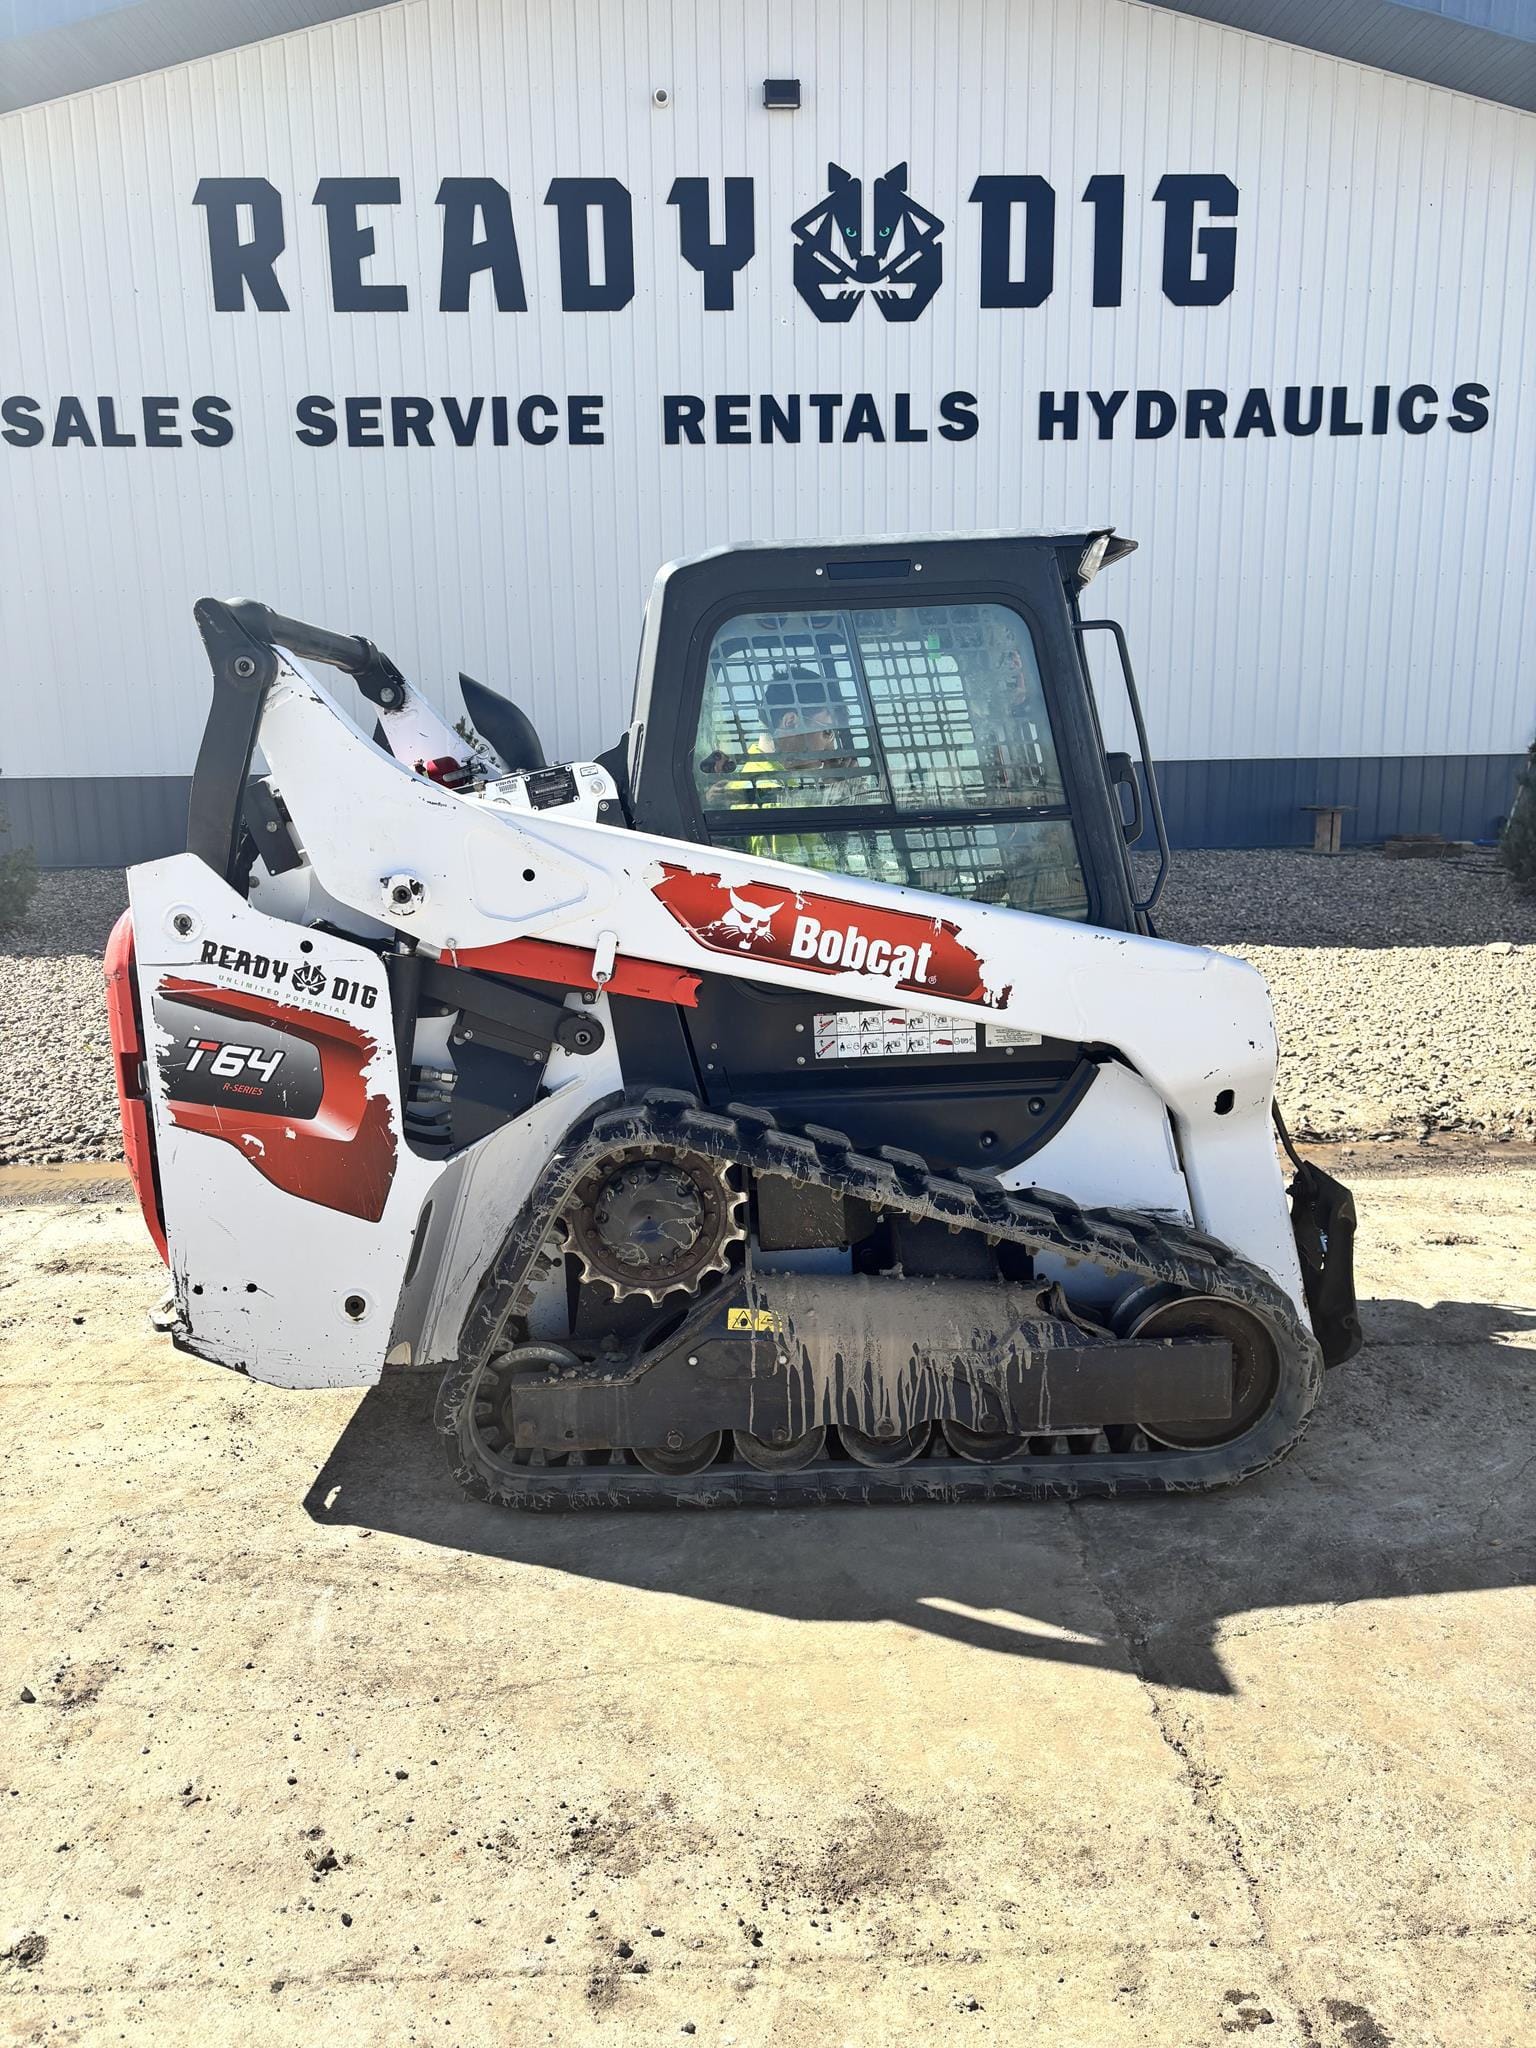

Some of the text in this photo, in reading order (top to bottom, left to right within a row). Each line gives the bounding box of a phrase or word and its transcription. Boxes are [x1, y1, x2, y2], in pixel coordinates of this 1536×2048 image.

[192, 177, 755, 313] READY
[1, 383, 1491, 448] SALES SERVICE RENTALS HYDRAULICS
[200, 940, 289, 984] READY
[790, 915, 932, 983] Bobcat
[218, 974, 347, 1016] UNLIMITED POTENTIAL
[185, 1038, 285, 1082] T64
[222, 1082, 264, 1096] R-SERIES
